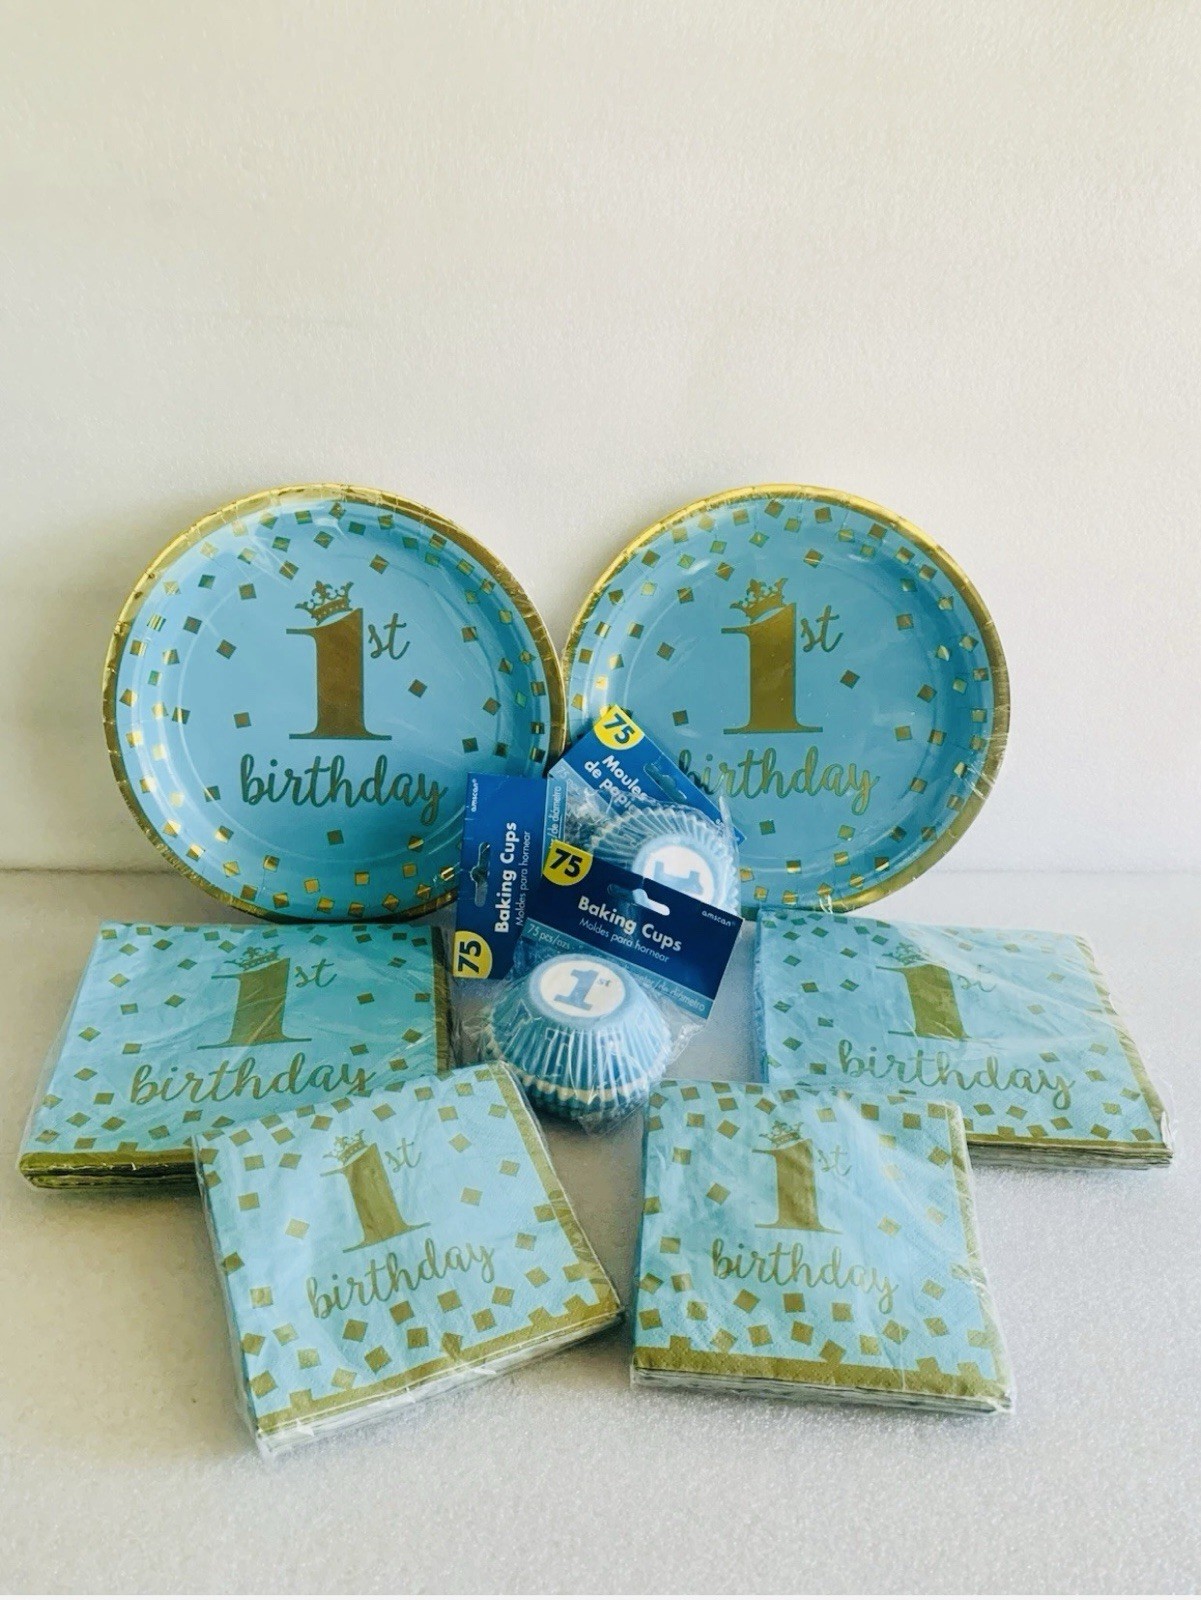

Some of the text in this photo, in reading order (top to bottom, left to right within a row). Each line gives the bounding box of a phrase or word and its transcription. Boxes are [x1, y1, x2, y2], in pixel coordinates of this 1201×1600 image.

[286, 607, 411, 741] 1st
[721, 602, 844, 735] 1st
[603, 713, 635, 745] 75
[239, 753, 448, 826] birthday
[584, 760, 602, 779] de
[494, 822, 520, 933] Baking Cups
[515, 831, 531, 926] Moldes para hornear
[550, 848, 583, 878] 75
[457, 940, 482, 974] 75
[527, 923, 540, 937] 75
[578, 895, 683, 952] Baking Cups
[579, 917, 671, 963] Moldes para hornear
[197, 957, 338, 1050] 1st
[553, 968, 611, 1012] 1st
[130, 1052, 376, 1105] birthday
[838, 1039, 1075, 1111] birthday
[320, 1138, 432, 1254] 1st
[752, 1138, 851, 1234] 1st
[305, 1237, 496, 1319] birthday
[710, 1237, 899, 1315] birthday
